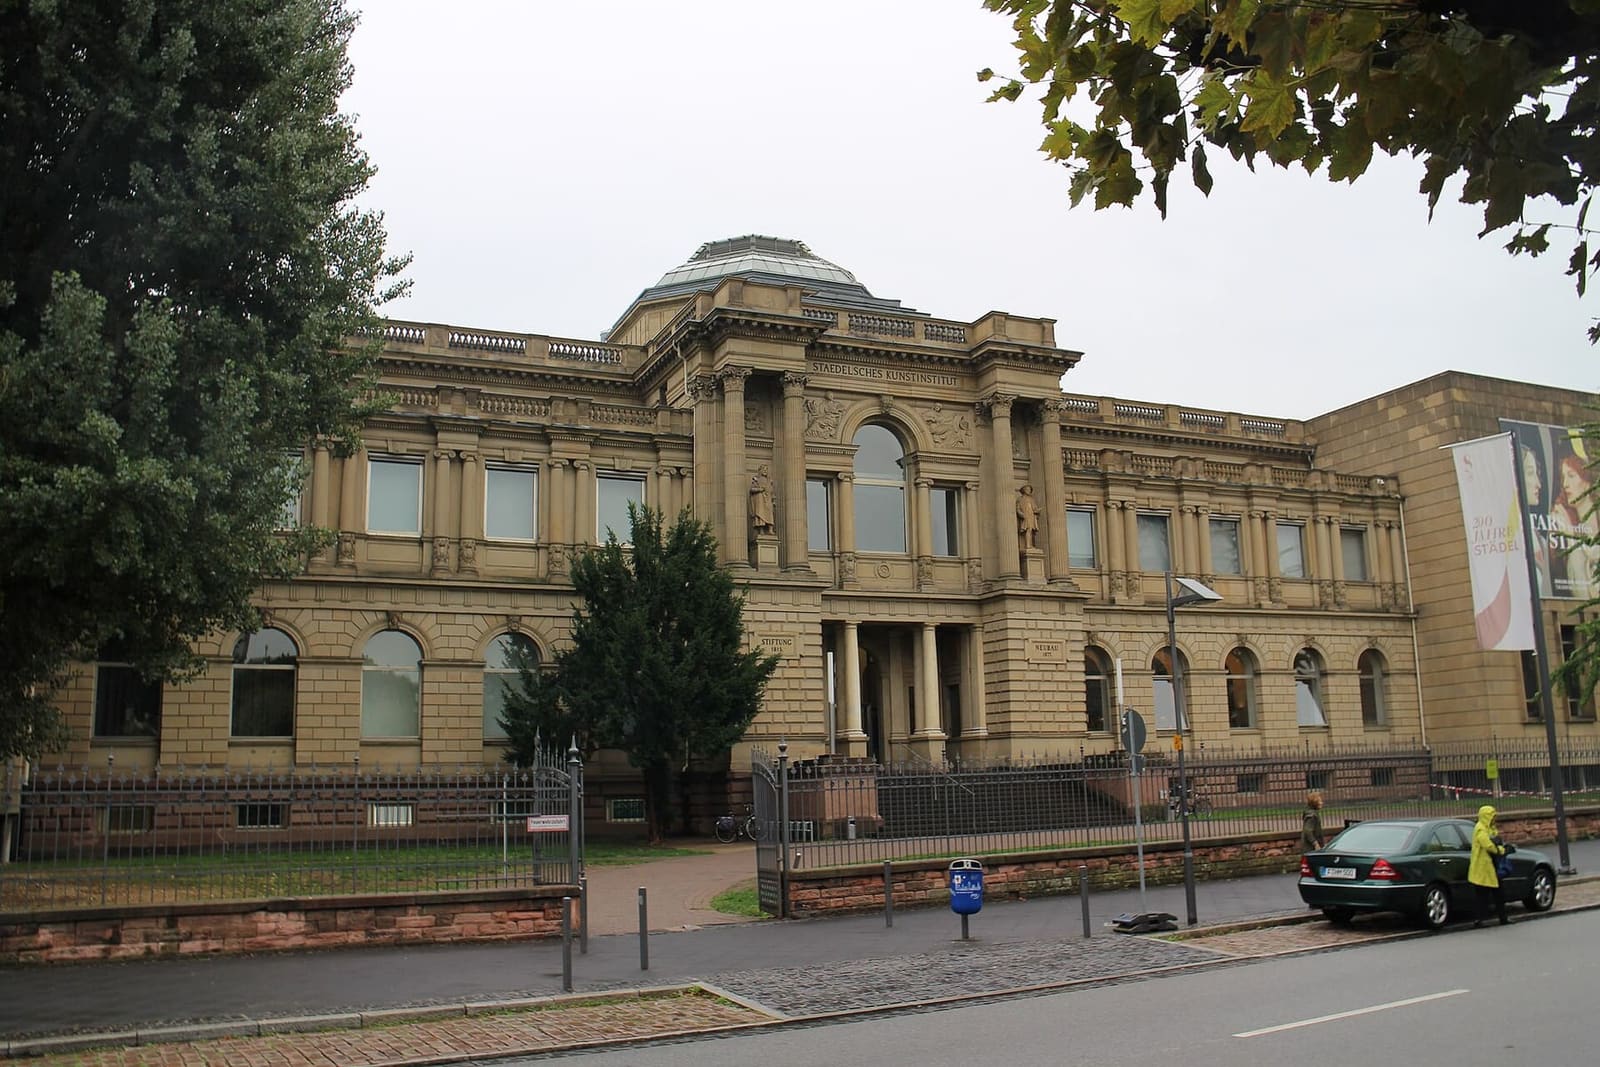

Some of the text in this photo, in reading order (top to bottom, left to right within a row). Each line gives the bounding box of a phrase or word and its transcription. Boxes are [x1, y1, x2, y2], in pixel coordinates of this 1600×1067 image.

[812, 362, 959, 386] STAEDELSCHES KUNSTINSTITUT
[1474, 540, 1520, 556] STÄDEL
[761, 638, 792, 646] STIFTUNG
